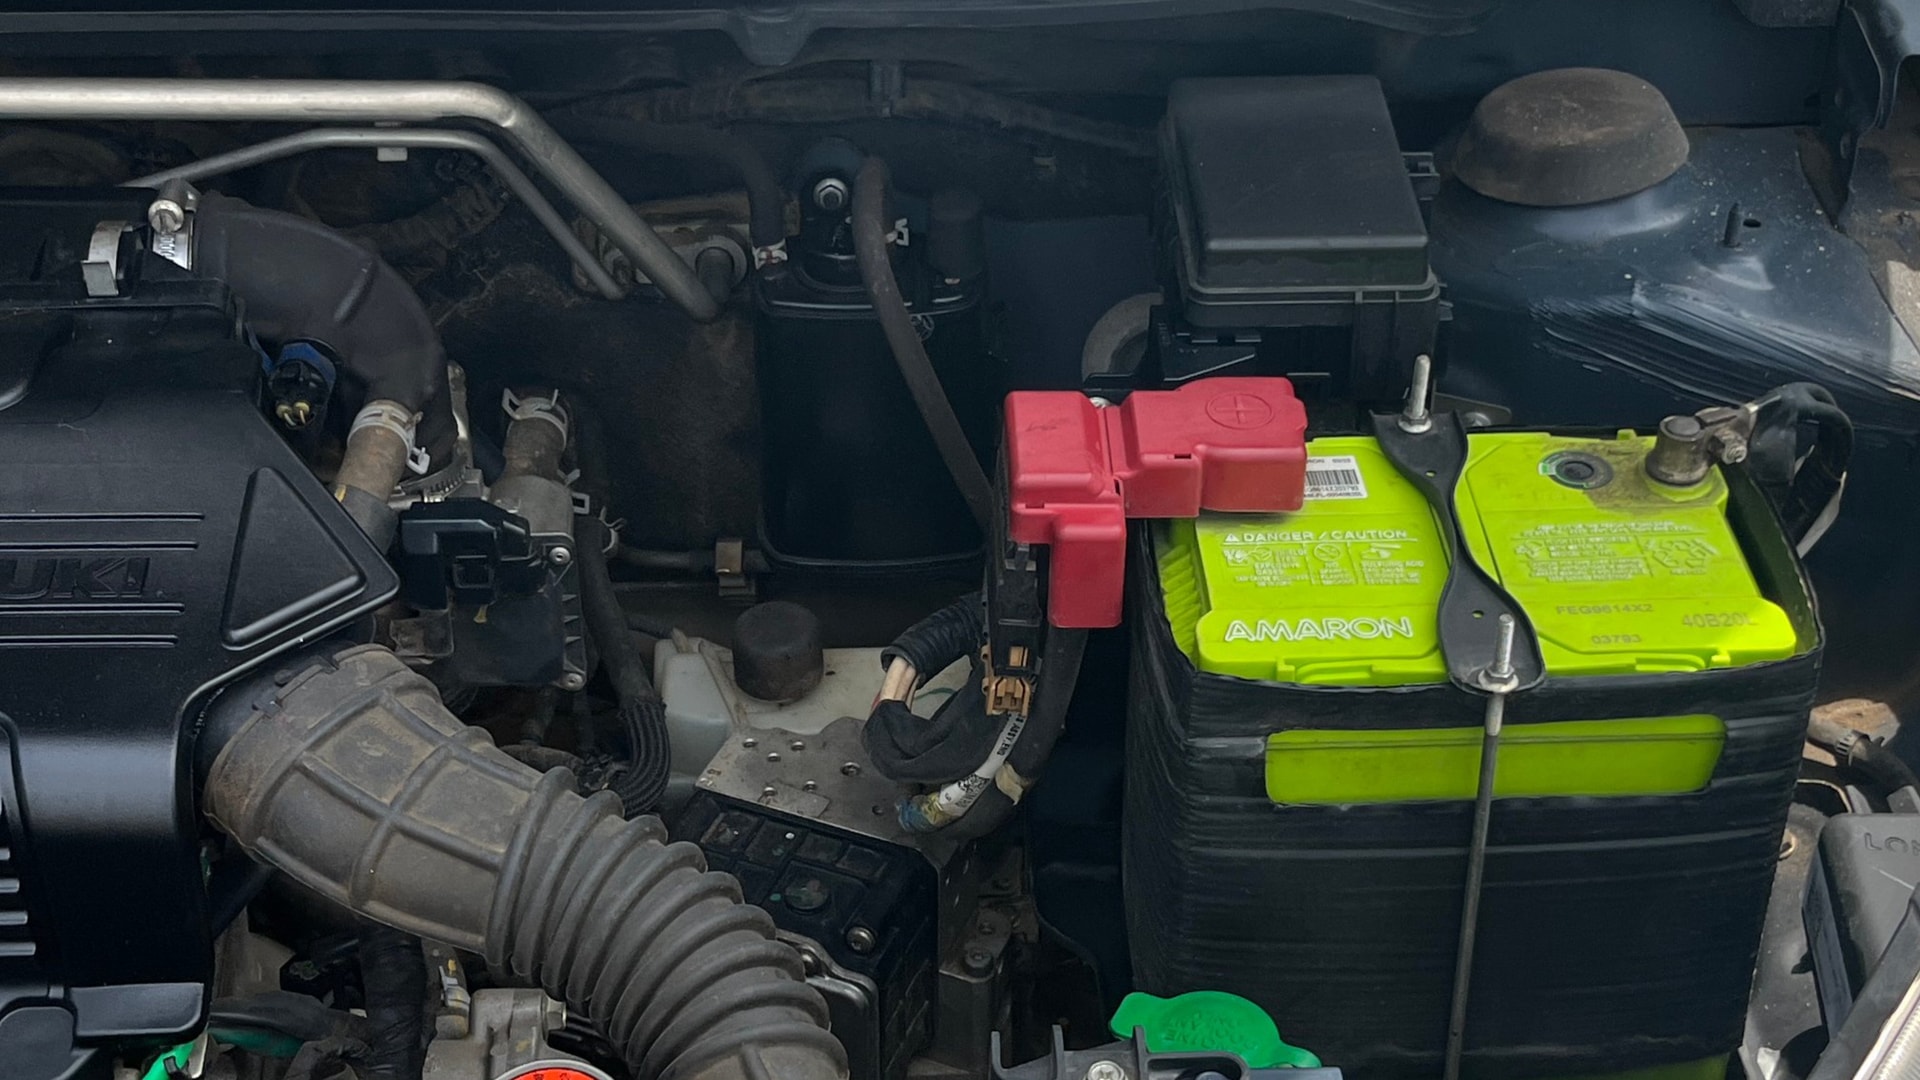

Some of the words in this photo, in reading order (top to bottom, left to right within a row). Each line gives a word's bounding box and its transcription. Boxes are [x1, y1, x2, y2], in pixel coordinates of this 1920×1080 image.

[1243, 532, 1314, 542] DANGER
[1331, 530, 1407, 541] CAUTION
[1225, 617, 1413, 642] AMARON
